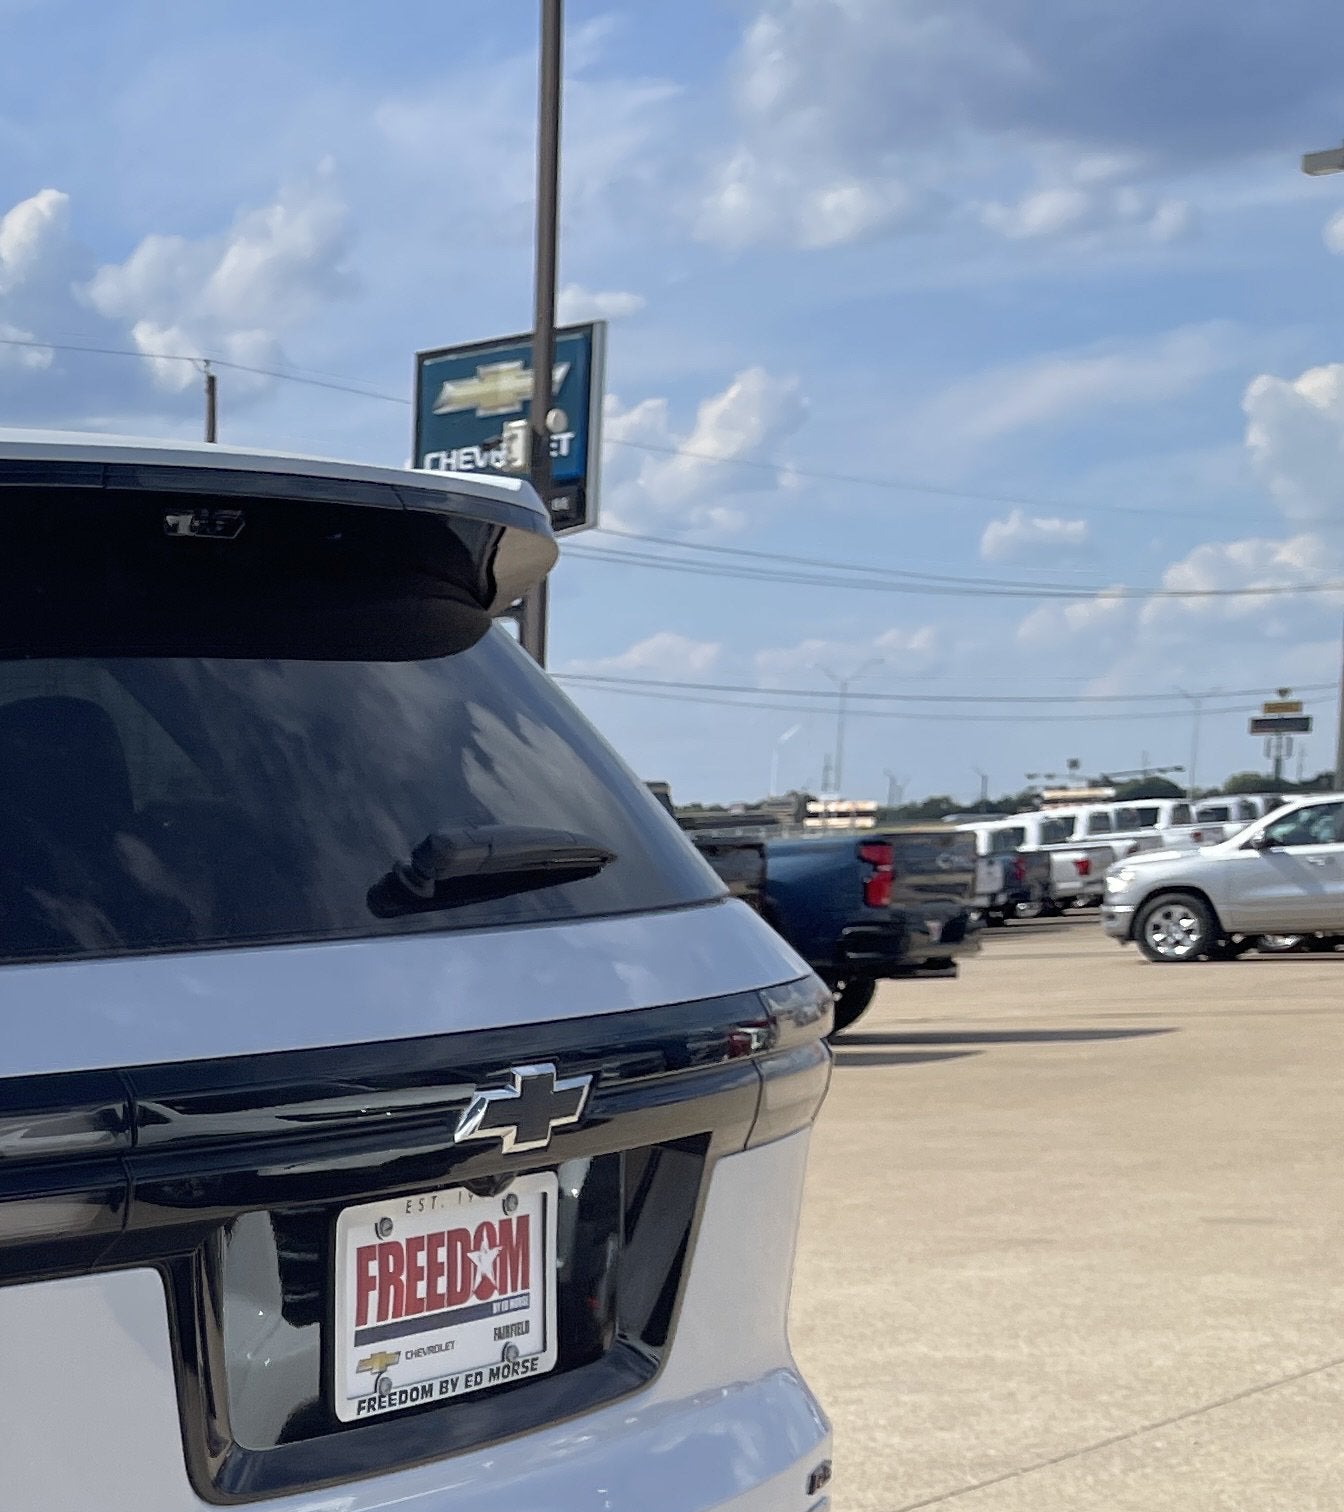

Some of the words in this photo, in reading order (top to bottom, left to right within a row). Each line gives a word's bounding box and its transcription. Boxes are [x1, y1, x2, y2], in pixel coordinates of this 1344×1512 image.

[406, 1194, 444, 1214] EST.
[355, 1214, 529, 1327] FREEDOM
[494, 1320, 529, 1341] FAIRFIELD
[405, 1340, 455, 1361] CHEVROLET
[356, 1383, 434, 1416] FREEDOM
[439, 1376, 460, 1396] BY
[464, 1371, 483, 1389] ED
[488, 1357, 539, 1383] MORSE
